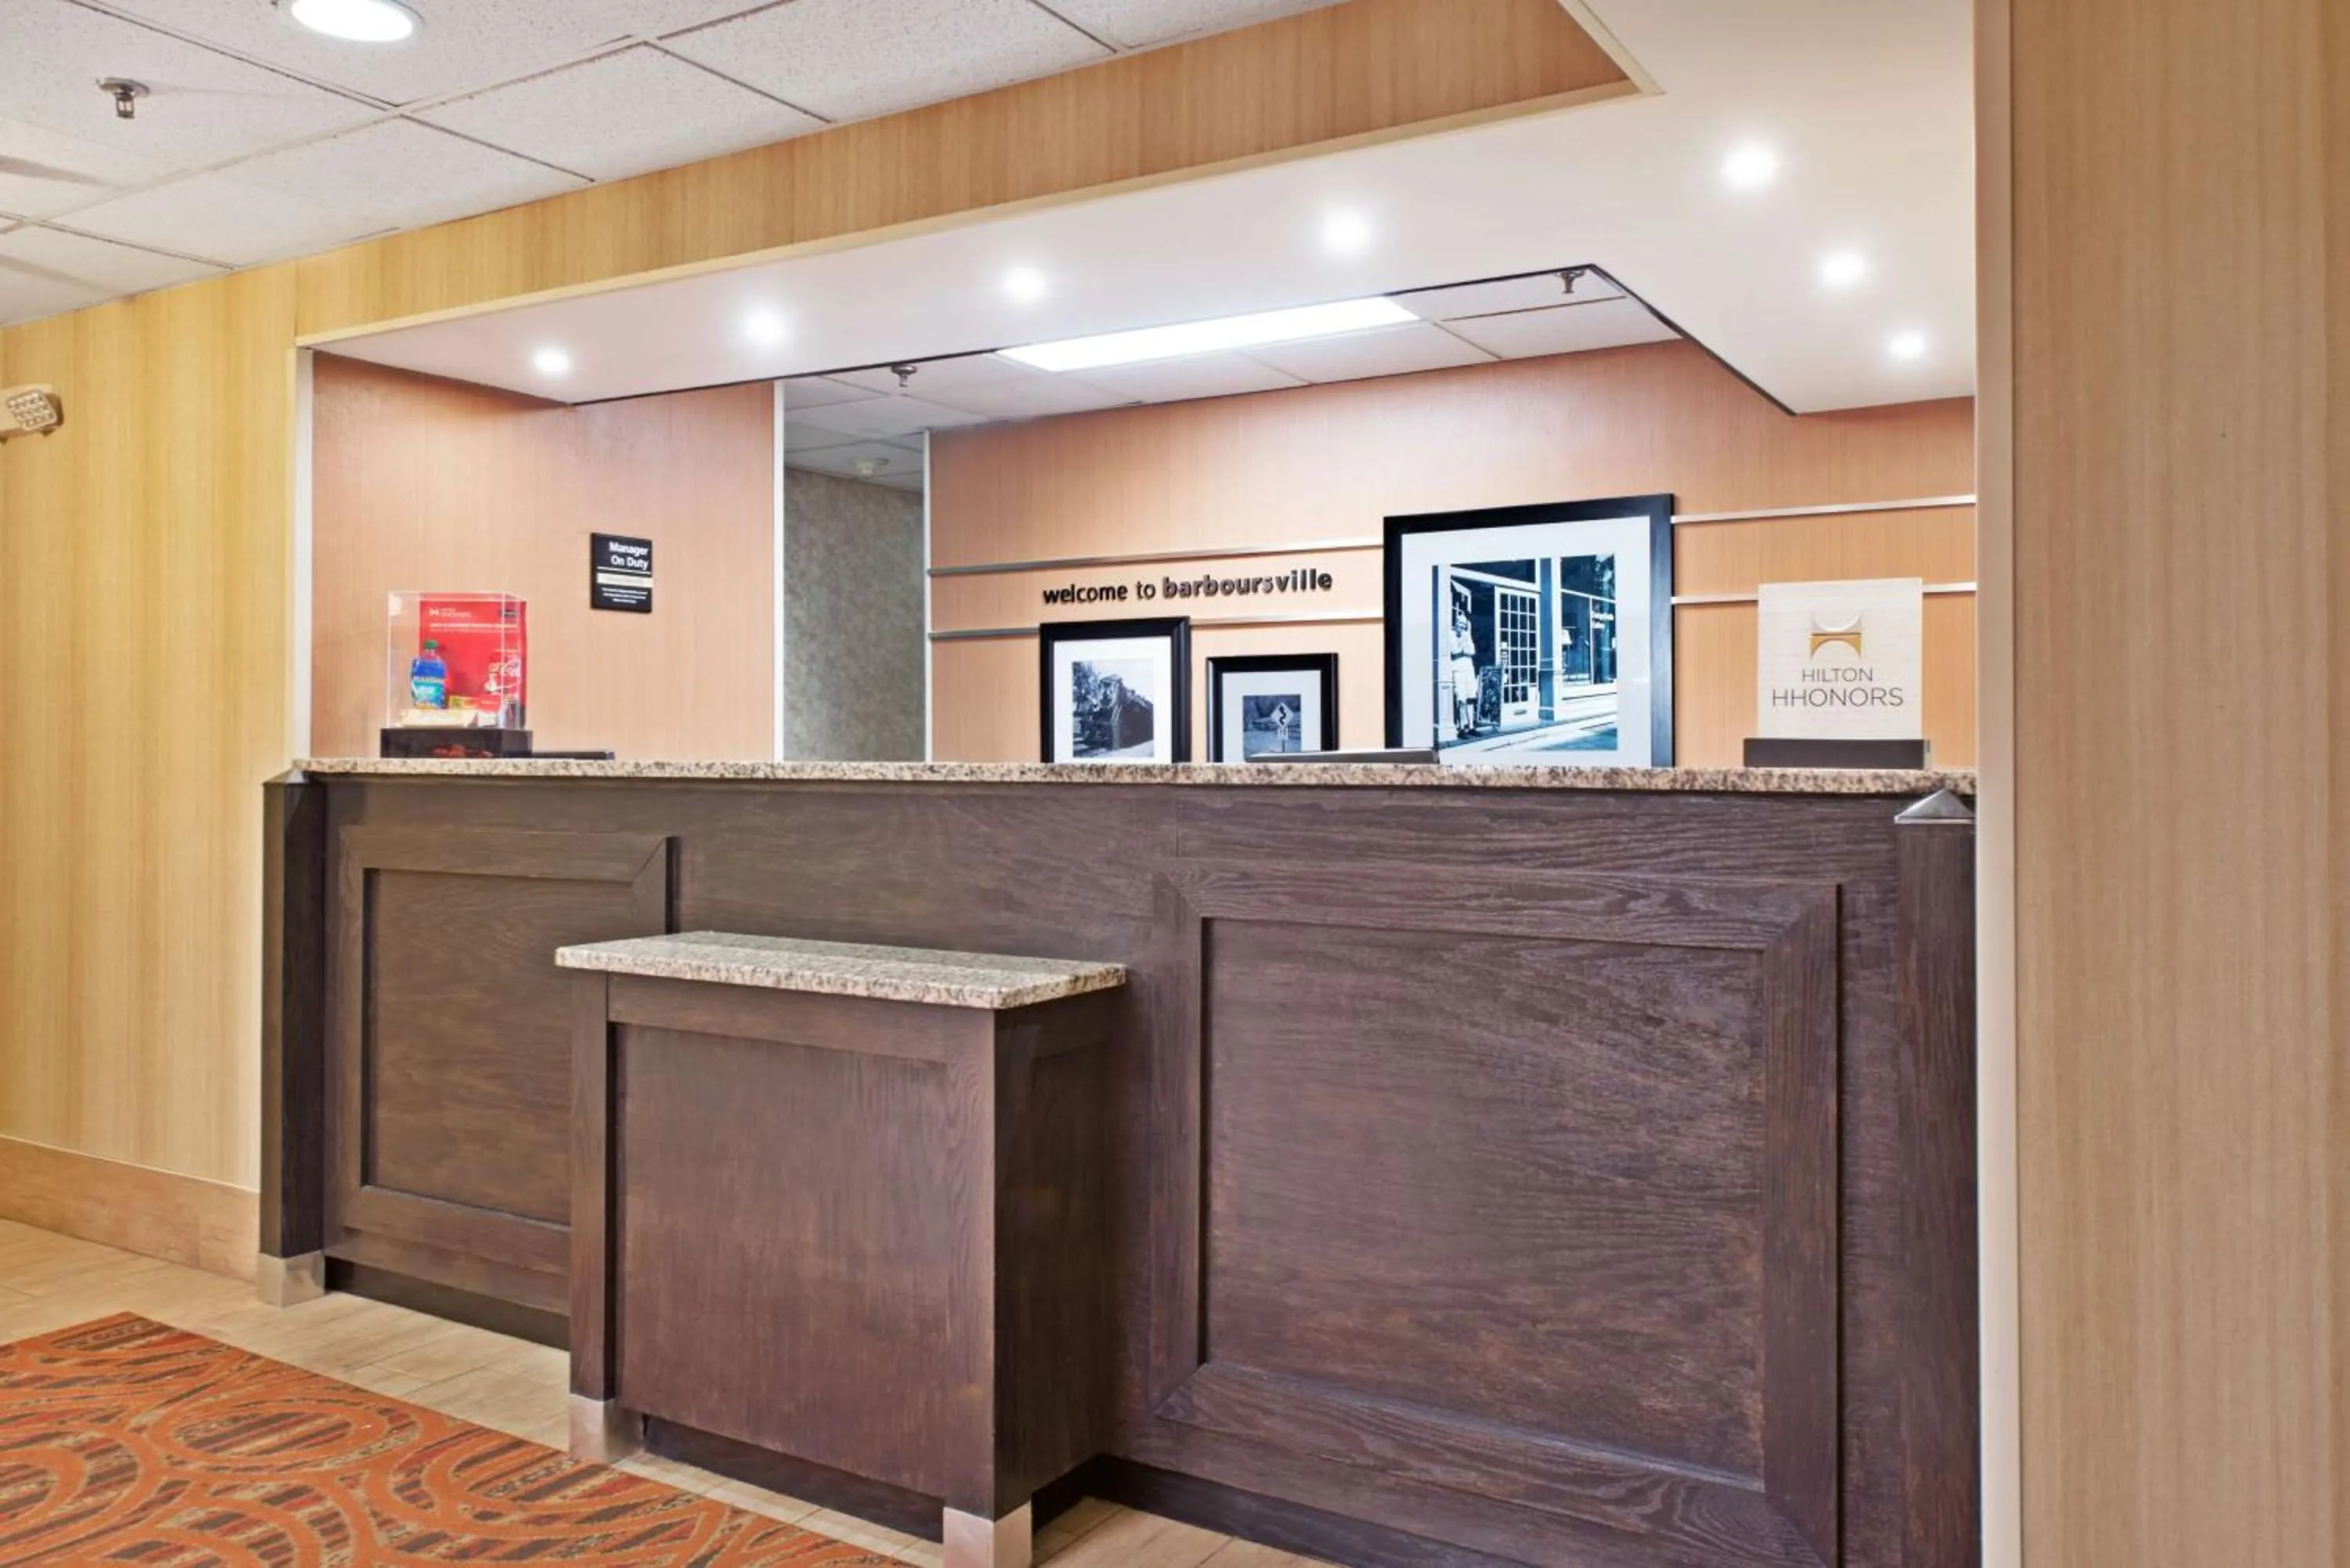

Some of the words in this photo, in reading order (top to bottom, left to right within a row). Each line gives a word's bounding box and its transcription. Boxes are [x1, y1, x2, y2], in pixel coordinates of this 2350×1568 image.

[609, 541, 649, 557] Manager
[611, 555, 624, 565] On
[627, 557, 649, 570] Duty
[1043, 583, 1128, 605] welcome
[1136, 580, 1156, 599] to
[1162, 569, 1333, 599] barboursville
[1802, 667, 1873, 682] HILTON
[1773, 688, 1904, 706] HHONORS
